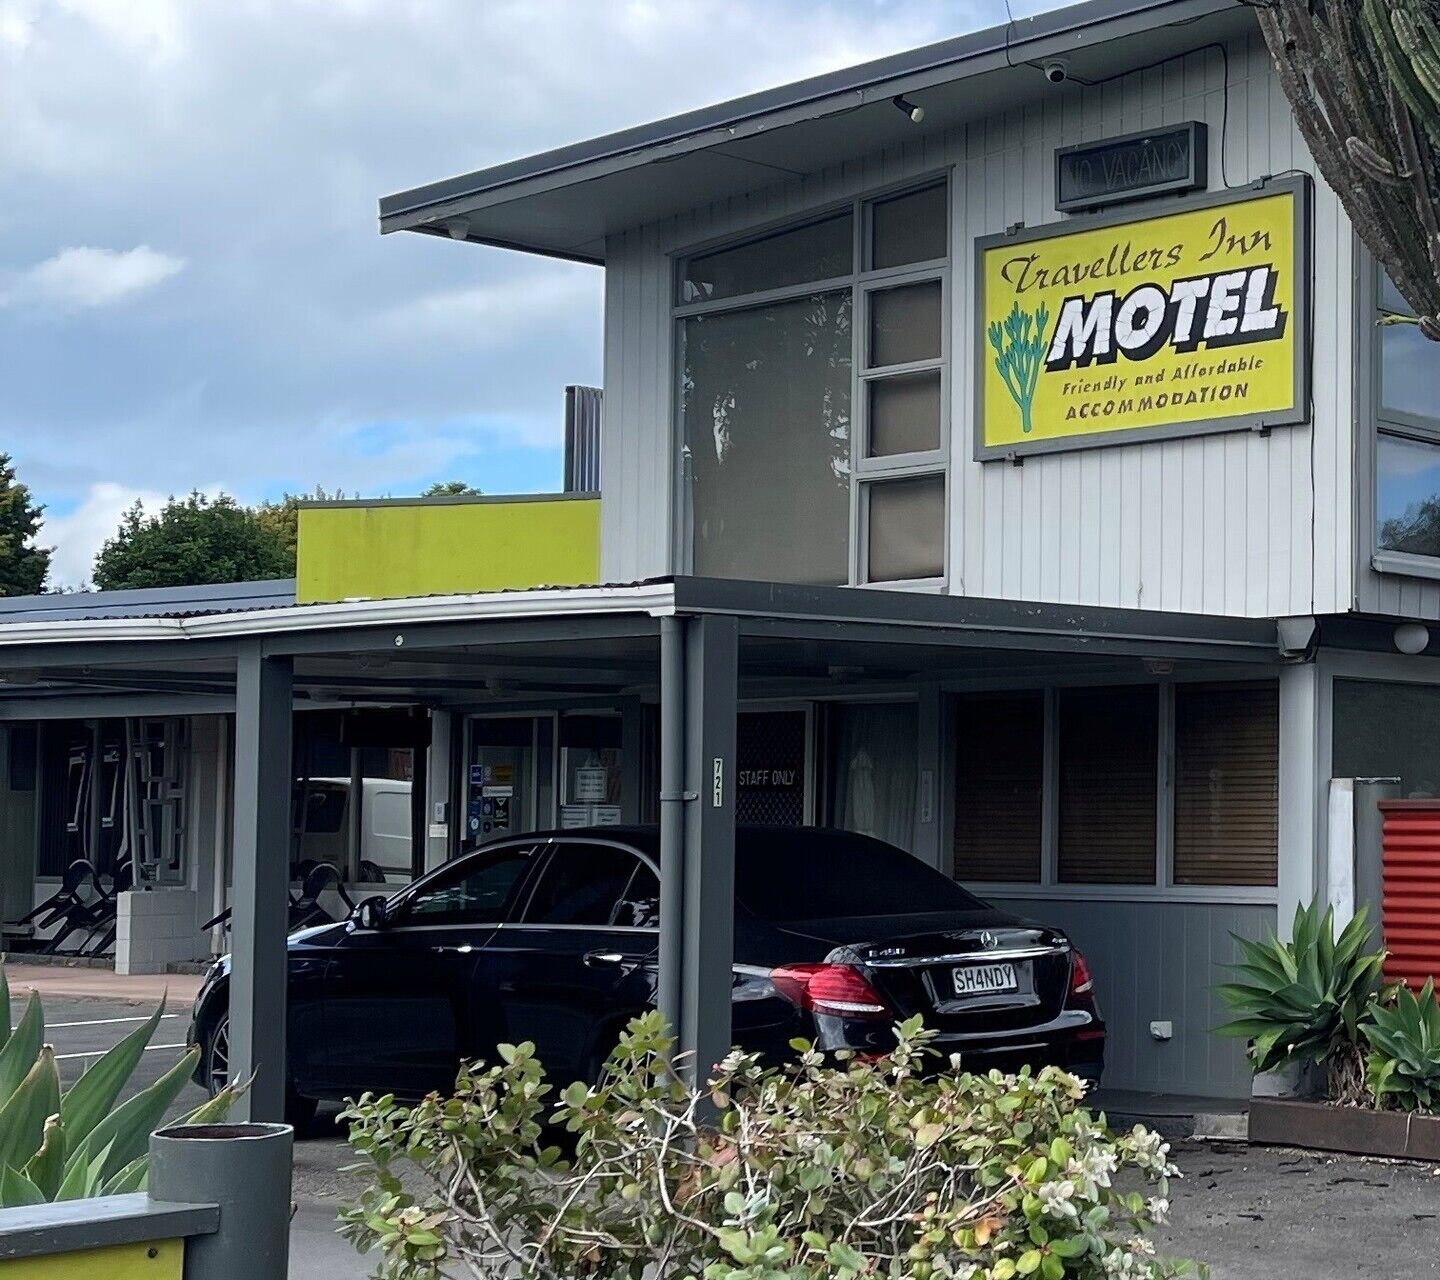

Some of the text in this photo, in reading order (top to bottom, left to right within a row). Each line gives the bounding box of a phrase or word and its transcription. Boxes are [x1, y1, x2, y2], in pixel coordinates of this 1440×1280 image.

[1102, 138, 1187, 190] VACANCY
[1001, 217, 1272, 293] Travellers Inn
[1044, 263, 1288, 372] MOTEL
[1062, 355, 1264, 396] Friendly and Affordable
[1065, 383, 1249, 420] ACCOMMODATION
[740, 770, 795, 786] STAFF ONLY
[955, 965, 1012, 990] SH4NDY
